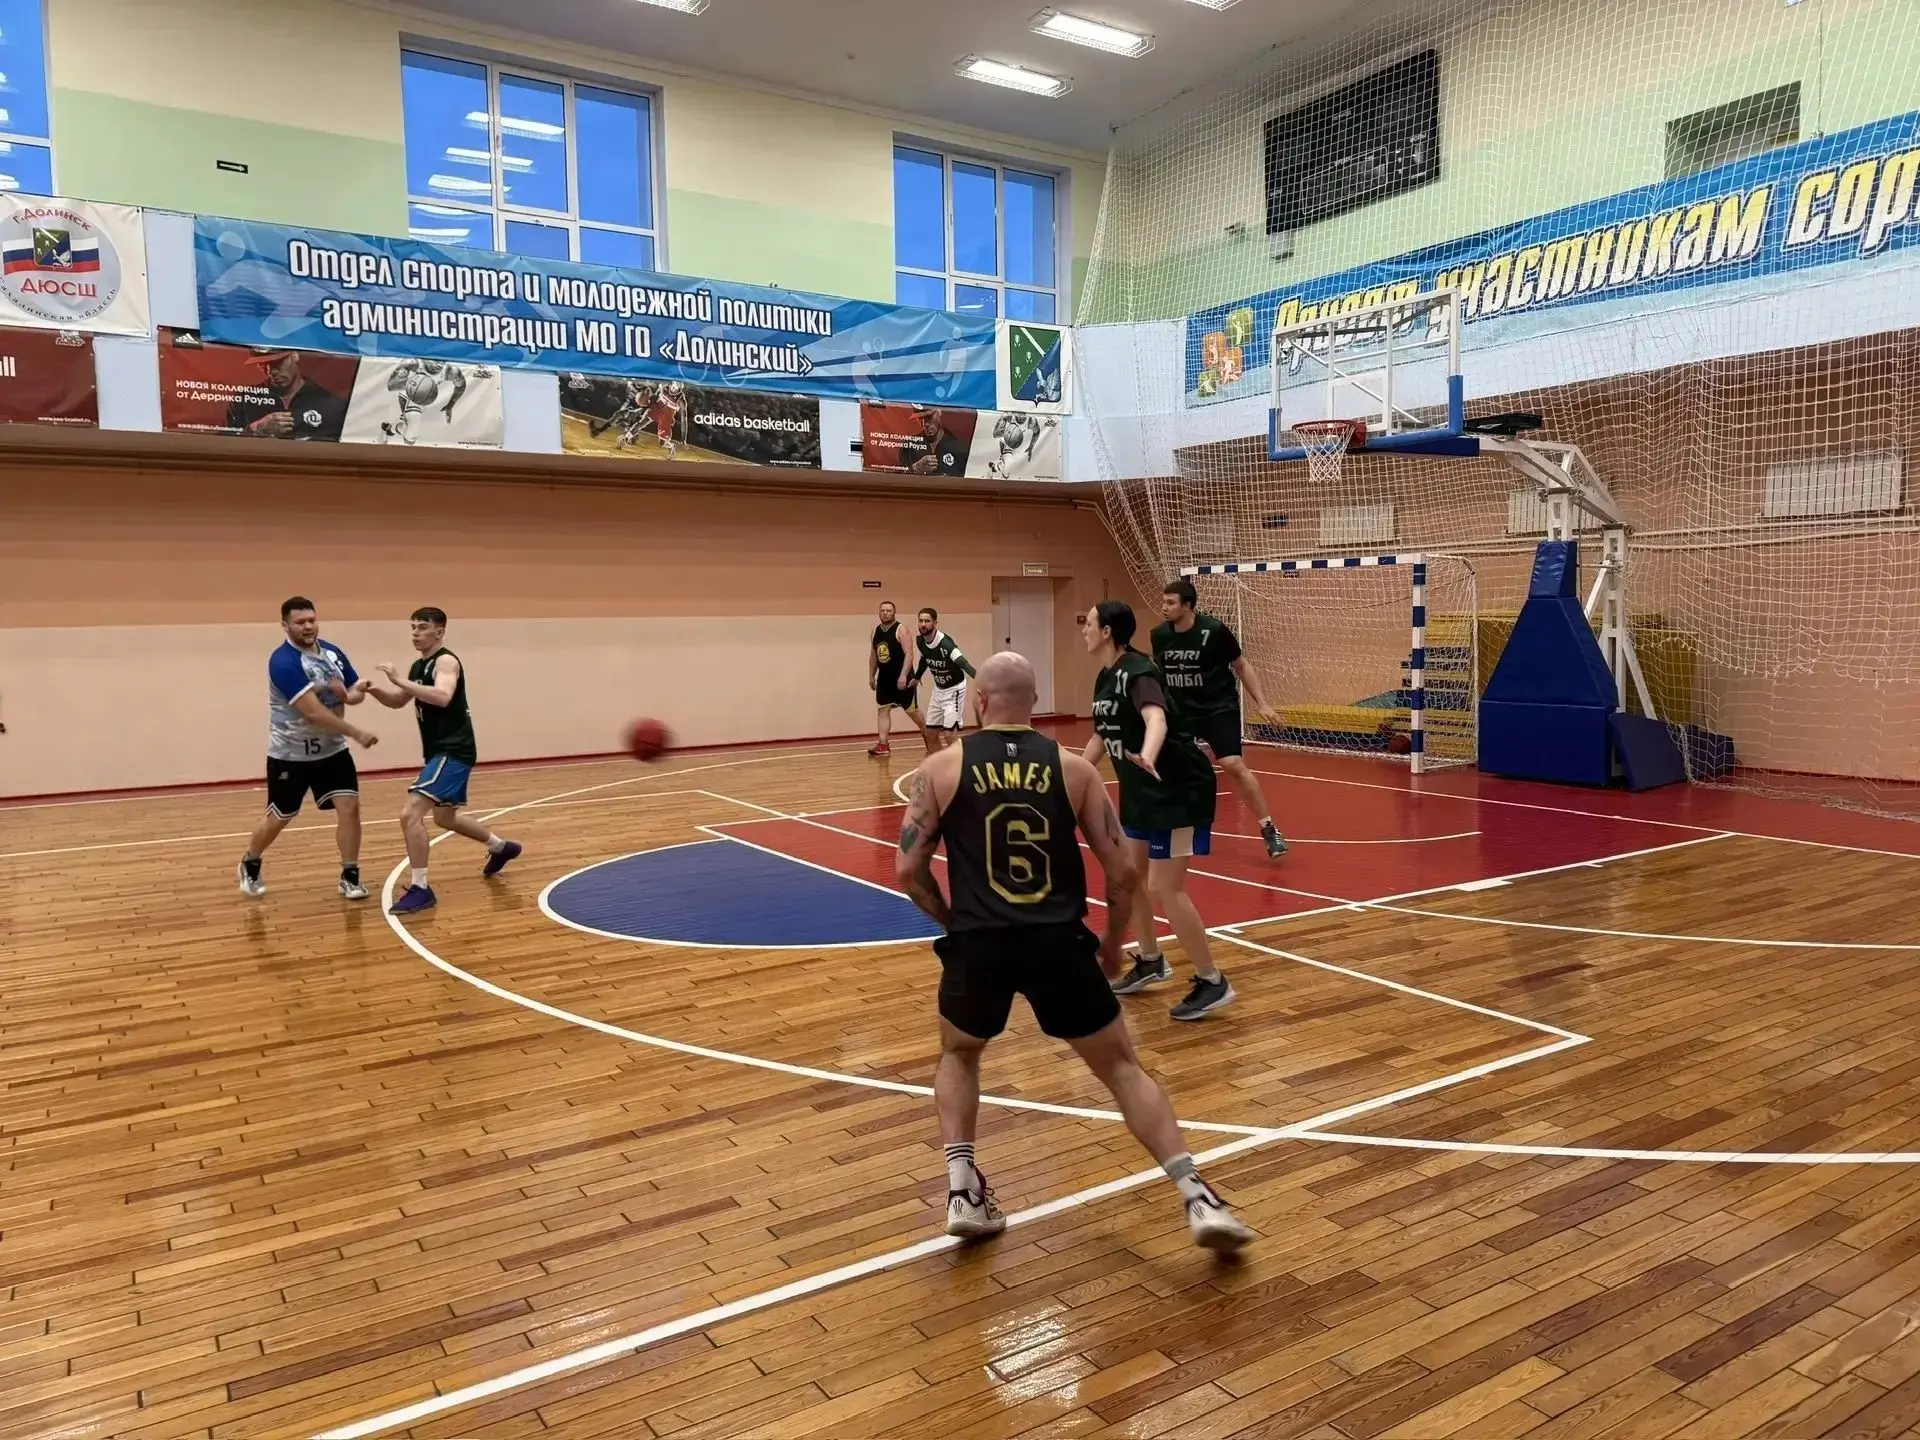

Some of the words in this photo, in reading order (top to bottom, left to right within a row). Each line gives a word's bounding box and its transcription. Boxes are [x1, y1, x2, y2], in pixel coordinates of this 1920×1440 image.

[1784, 149, 1920, 250] сор
[21, 278, 97, 297] ДЮСШ
[288, 240, 394, 288] Отдел
[402, 259, 515, 300] спорта
[524, 273, 540, 302] и
[549, 276, 711, 322] молодежной
[719, 299, 831, 336] политики
[323, 299, 567, 353] администрации
[576, 319, 616, 354] МО
[625, 325, 650, 358] ГО
[660, 330, 813, 375] «Долинский»
[0, 356, 16, 377] ll
[176, 380, 209, 389] новая
[211, 384, 269, 395] коллекция
[191, 391, 242, 402] Деррика
[244, 395, 275, 405] Роуза
[694, 412, 741, 428] adidas
[744, 415, 810, 432] basketball
[1201, 629, 1210, 646] 7
[1164, 650, 1201, 660] PARI
[303, 738, 321, 755] 15
[971, 762, 1052, 794] JAMES
[985, 803, 1052, 903] 6
